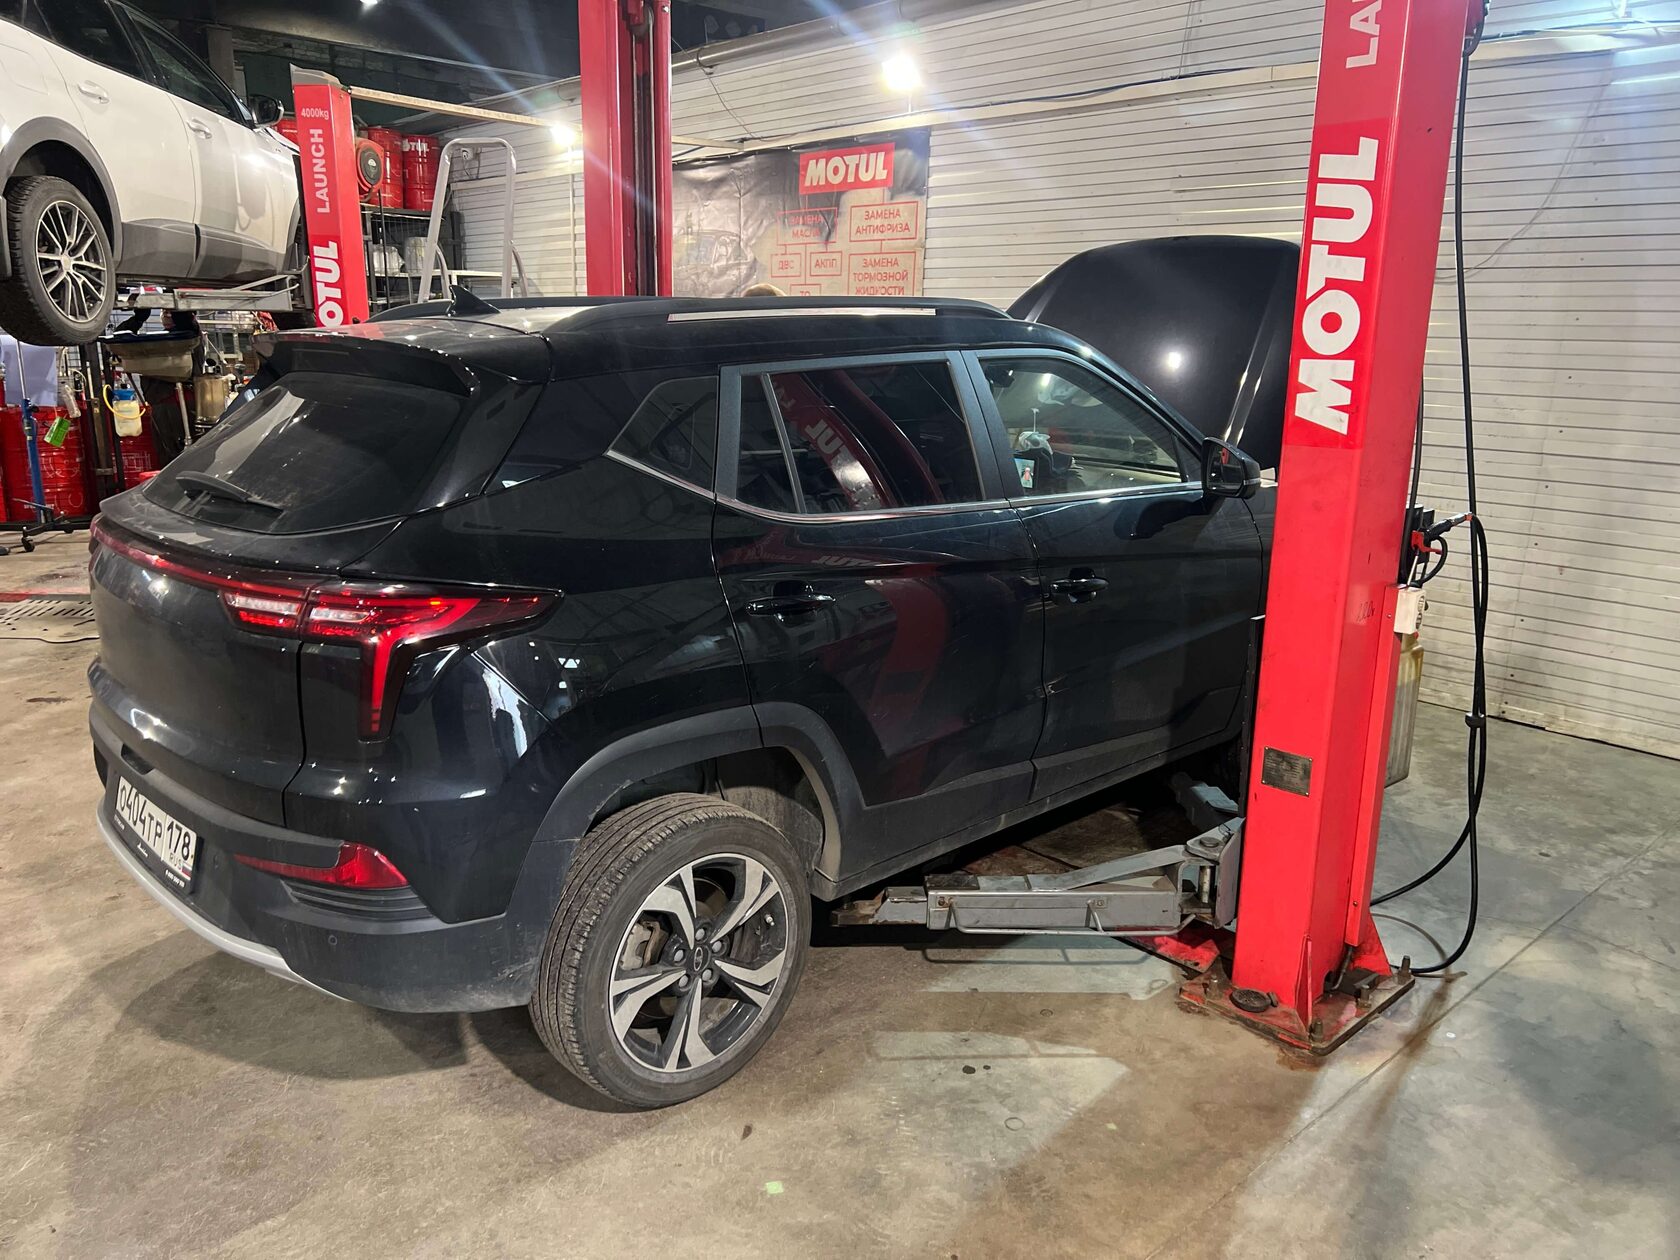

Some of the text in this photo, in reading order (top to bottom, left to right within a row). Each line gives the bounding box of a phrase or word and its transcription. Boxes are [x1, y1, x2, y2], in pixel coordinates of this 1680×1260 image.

[1346, 0, 1383, 69] LA
[301, 108, 329, 120] 4000kg
[310, 128, 330, 213] LAUNCH
[804, 152, 888, 187] MOTUL
[863, 208, 901, 221] ЗАМЕНА
[855, 222, 911, 236] АНТИФРИЗА
[815, 258, 837, 269] АКПП
[862, 257, 900, 268] ЗАМЕНА
[853, 269, 909, 283] ТОРМОЗНОЙ
[855, 285, 905, 296] ЖИДКОСТИ
[1294, 136, 1379, 436] MOTUL
[167, 820, 192, 861] 178
